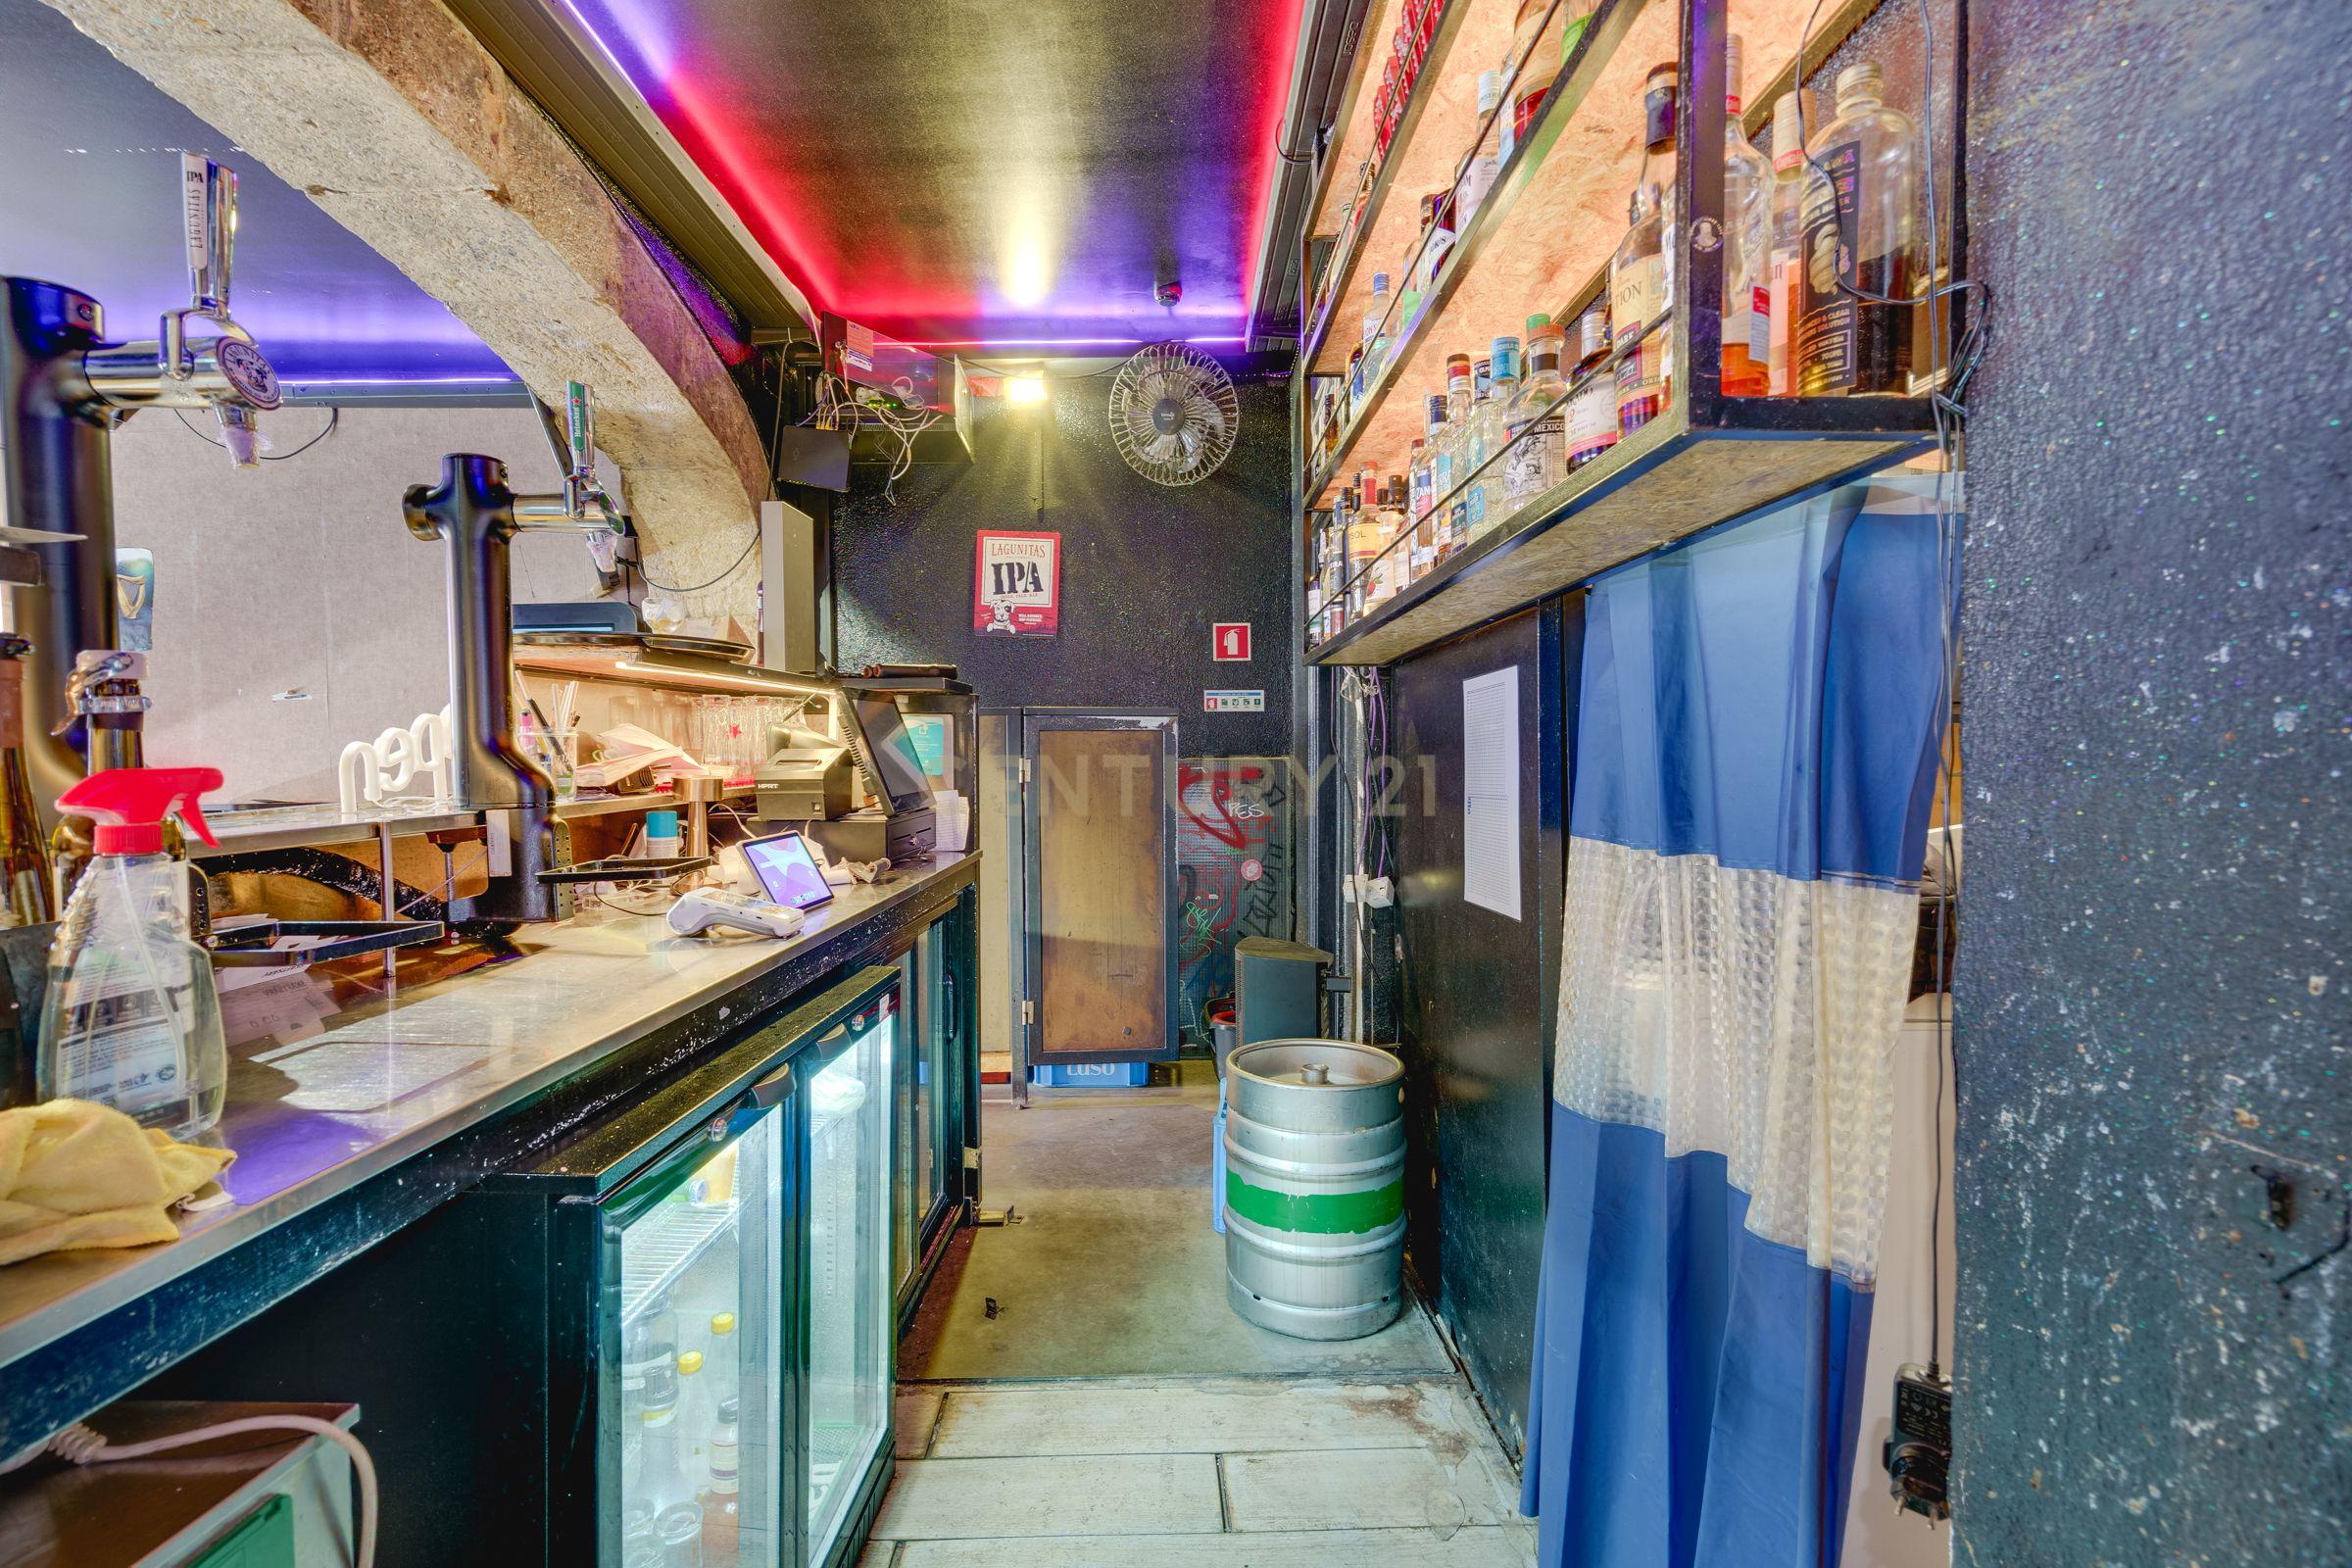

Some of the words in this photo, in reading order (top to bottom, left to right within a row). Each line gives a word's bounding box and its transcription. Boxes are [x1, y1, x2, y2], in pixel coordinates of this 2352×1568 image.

[186, 171, 204, 184] IPA
[187, 187, 204, 250] LAGUNITAS
[1534, 422, 1565, 433] MEXICO
[991, 543, 1046, 559] LAGUNITAS
[991, 561, 1044, 596] IPA
